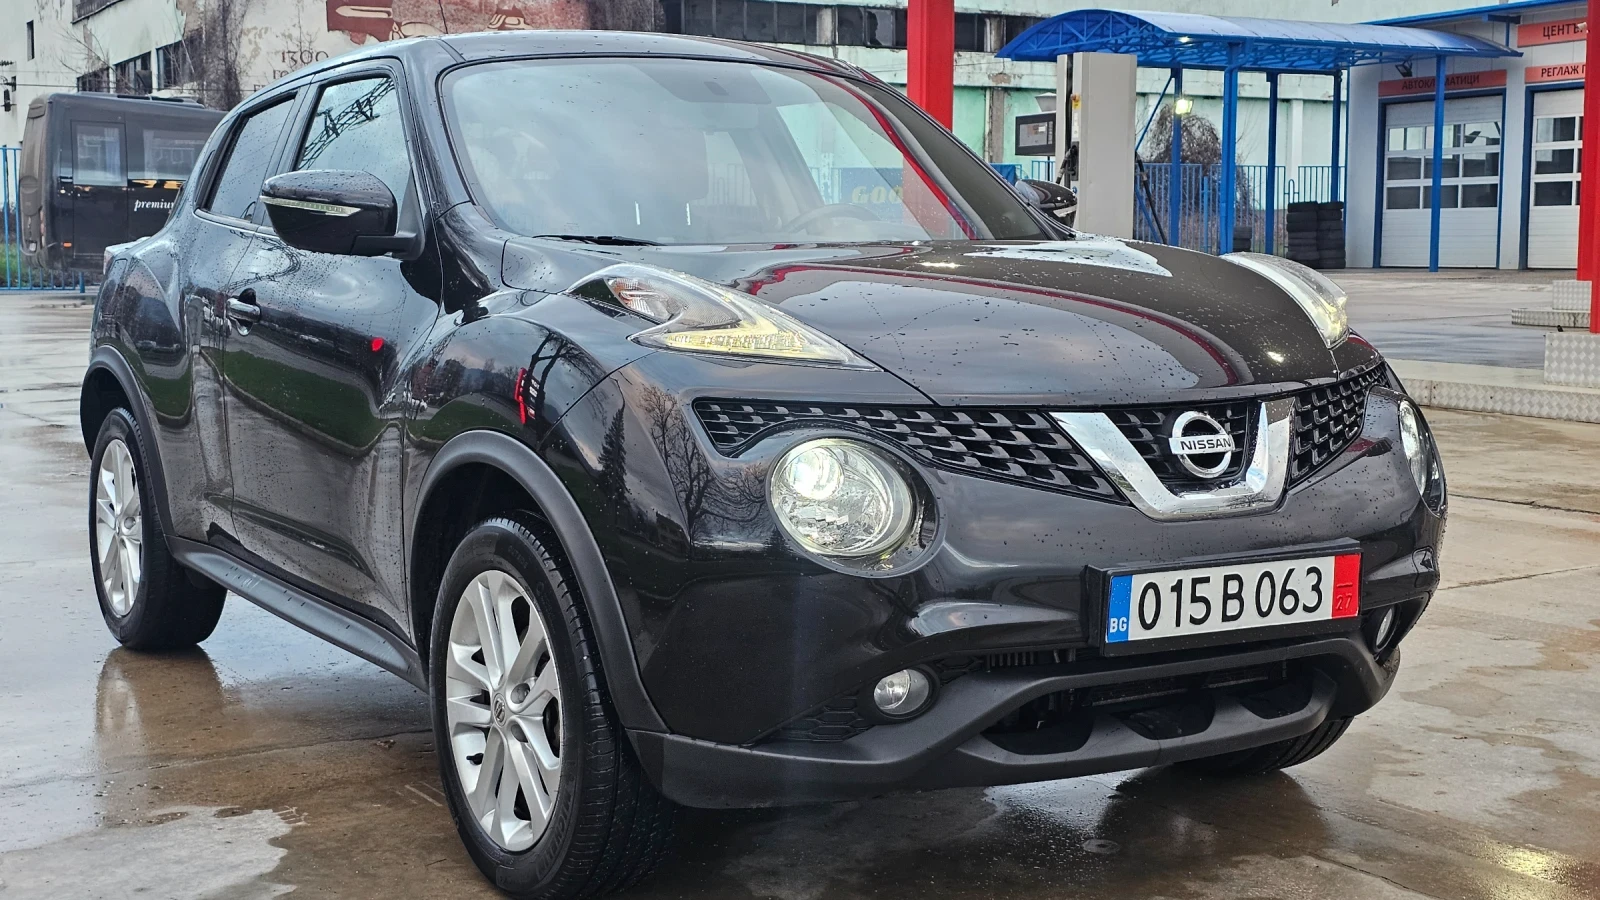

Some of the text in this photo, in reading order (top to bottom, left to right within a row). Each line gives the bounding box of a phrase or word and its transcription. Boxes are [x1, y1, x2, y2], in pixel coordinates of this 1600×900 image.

[1543, 22, 1583, 40] ЦЕНТЪ
[1541, 65, 1579, 78] РЕГЛАЖ
[1401, 74, 1480, 90] АВТОКЛМАТИЦИ
[1180, 437, 1232, 451] NISSAN
[1109, 617, 1127, 634] BG
